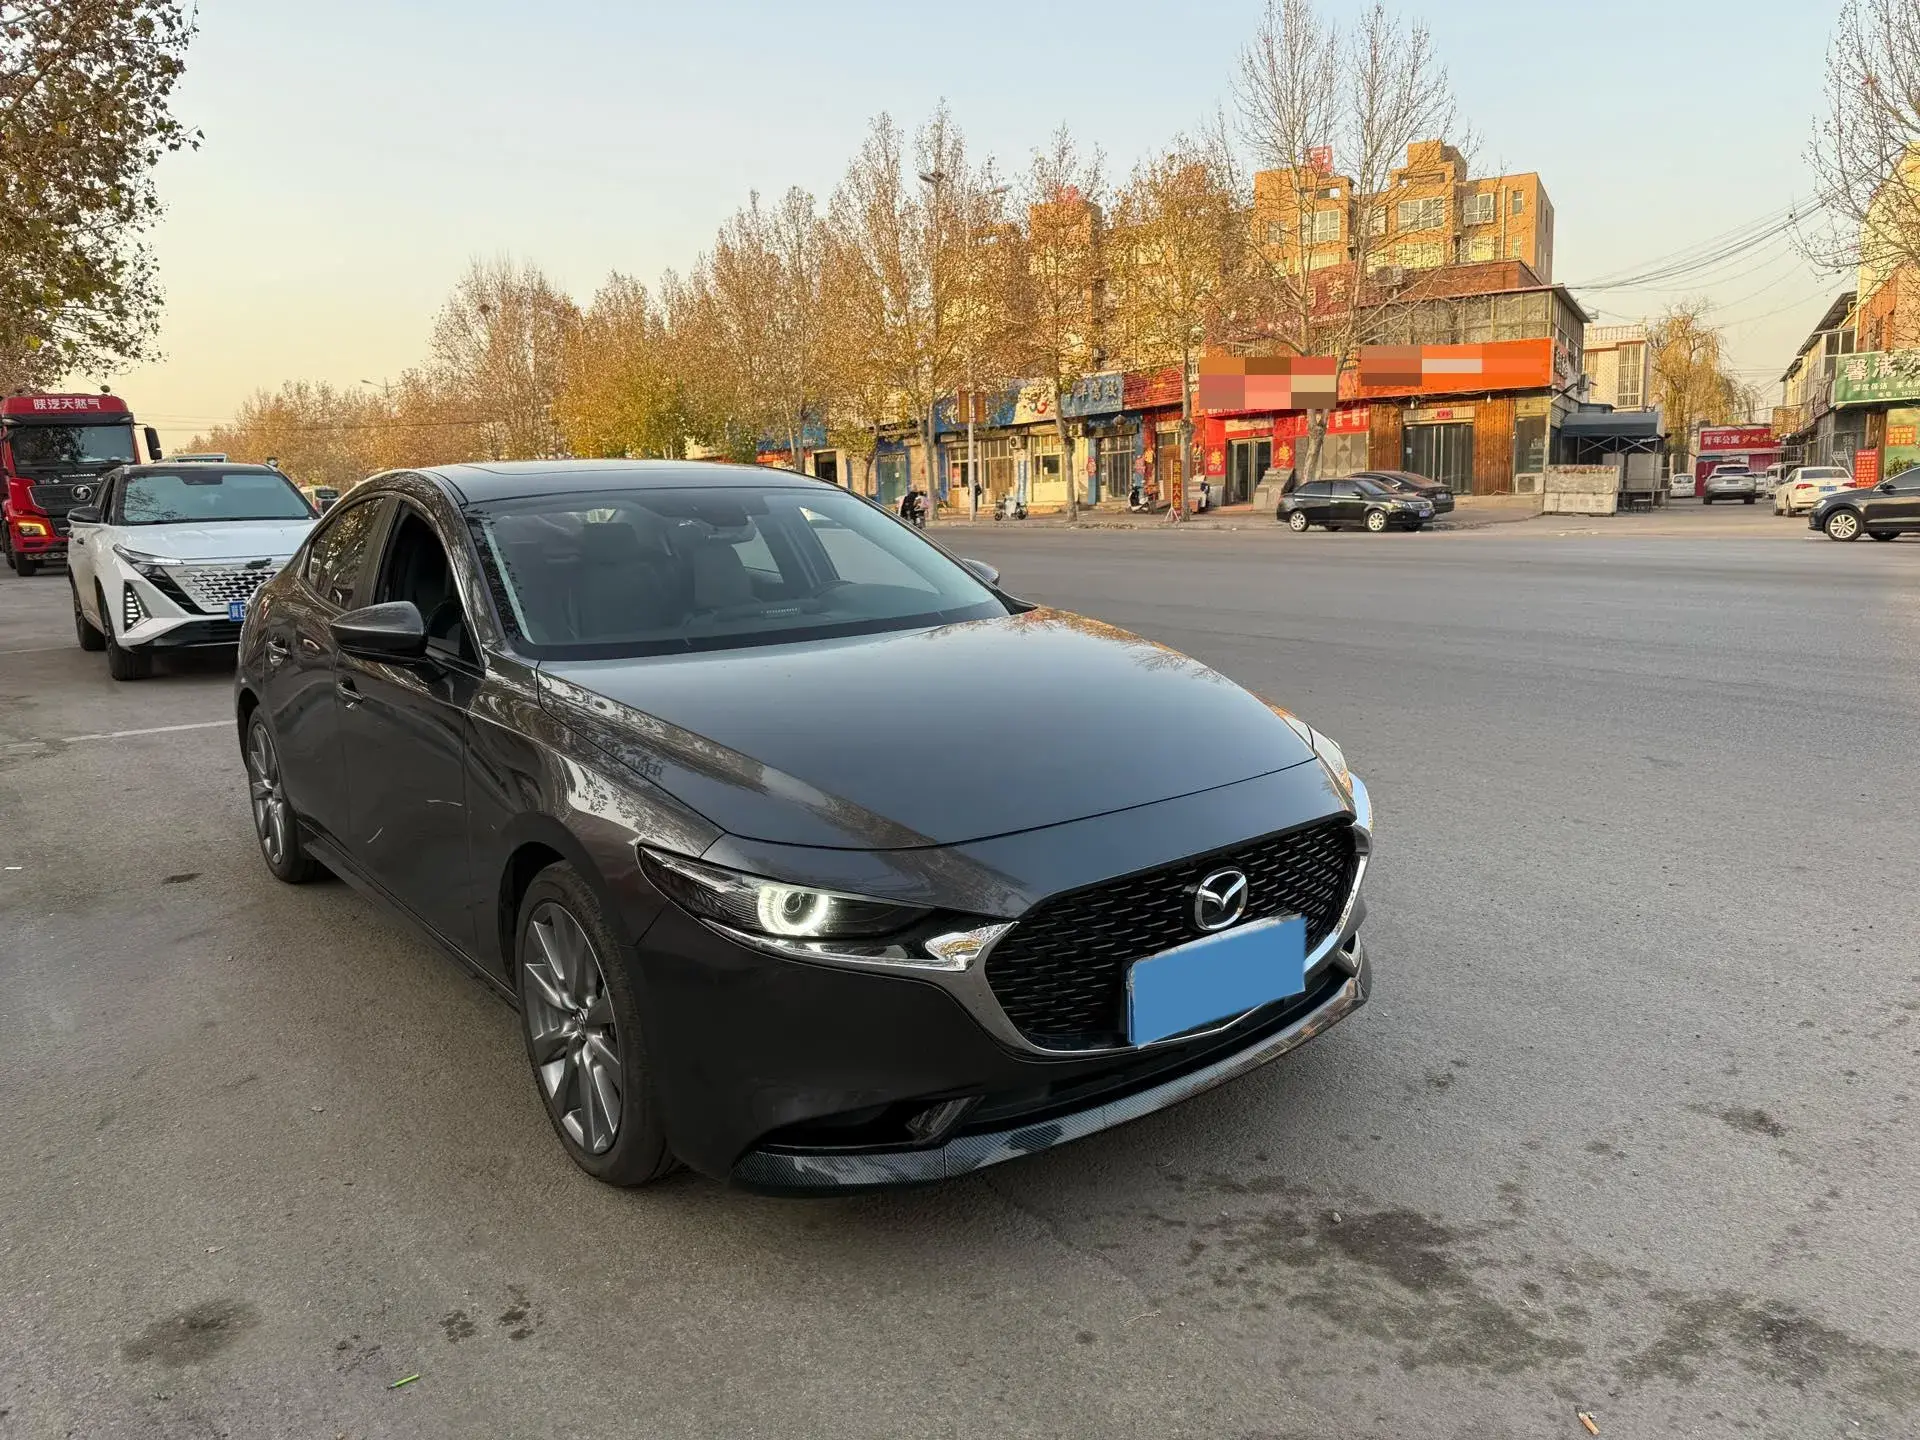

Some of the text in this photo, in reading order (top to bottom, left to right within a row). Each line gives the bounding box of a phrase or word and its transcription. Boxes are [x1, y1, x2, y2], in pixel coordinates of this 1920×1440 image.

[33, 398, 101, 410] 陕汽天然气
[1703, 434, 1740, 446] 青年公寓
